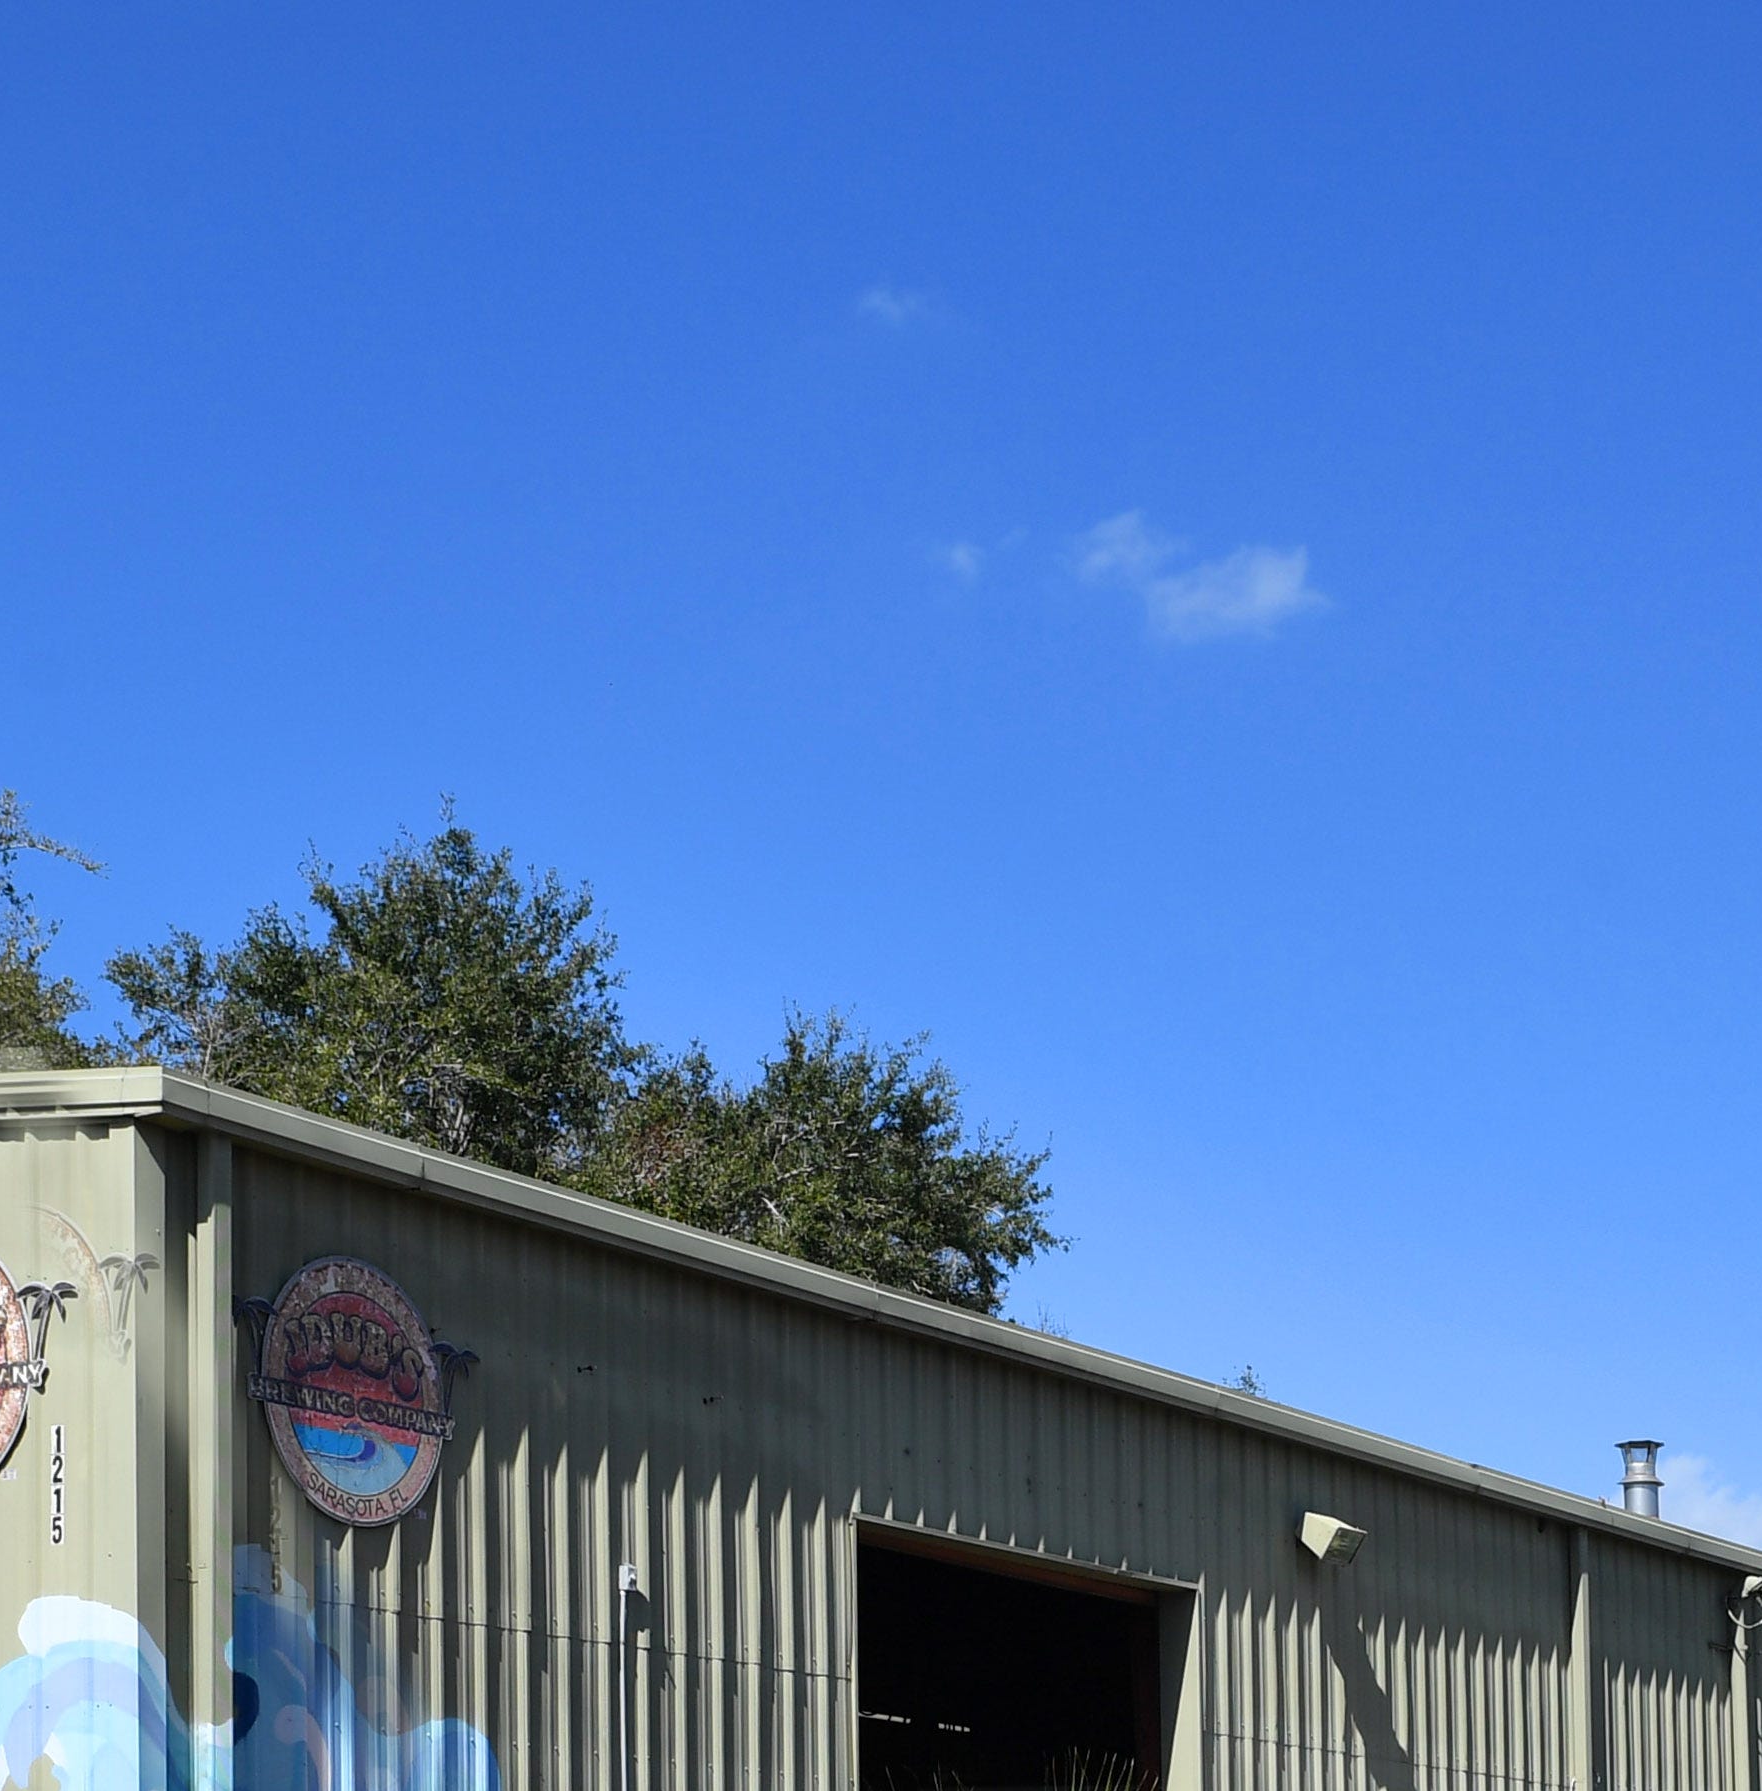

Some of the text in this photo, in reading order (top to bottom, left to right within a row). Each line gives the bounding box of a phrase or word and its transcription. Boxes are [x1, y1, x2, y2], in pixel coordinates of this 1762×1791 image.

[358, 1399, 454, 1437] COMPANY
[51, 1426, 64, 1543] 1215
[389, 1488, 409, 1511] FL
